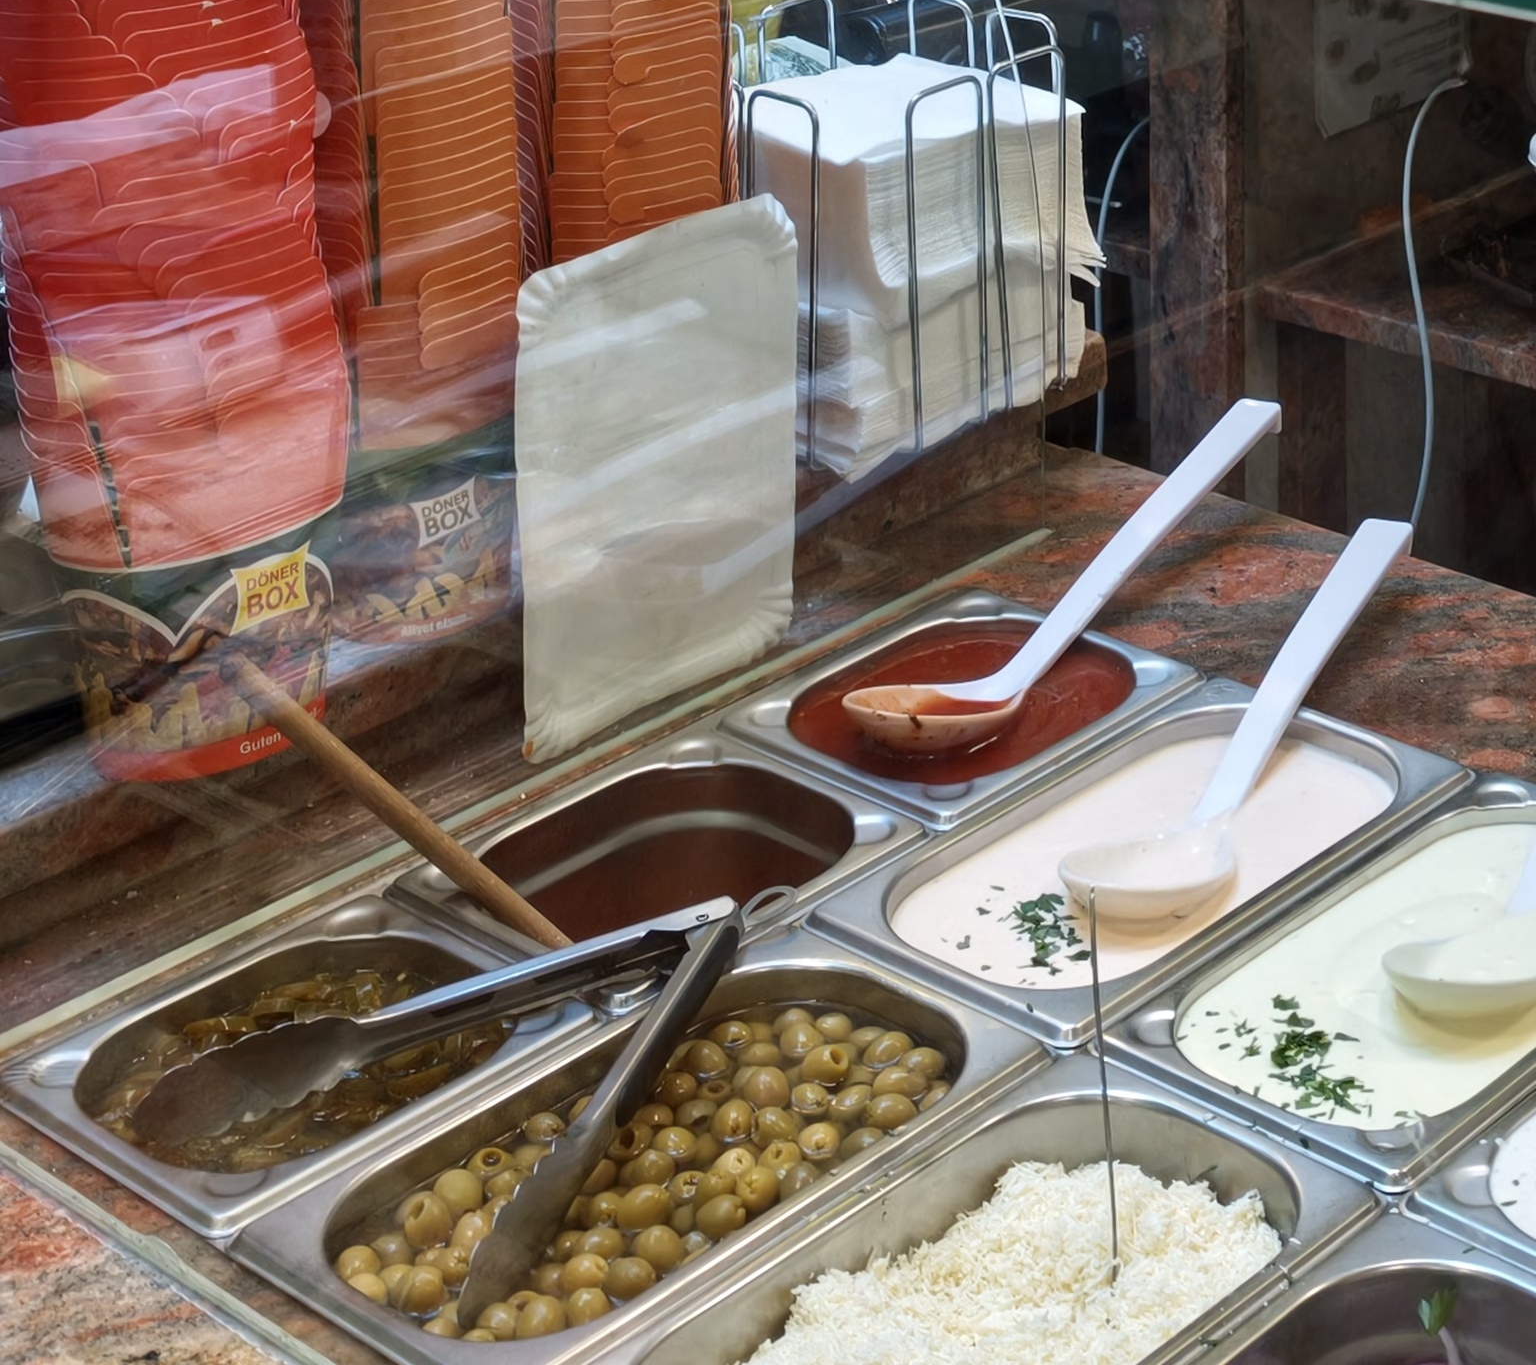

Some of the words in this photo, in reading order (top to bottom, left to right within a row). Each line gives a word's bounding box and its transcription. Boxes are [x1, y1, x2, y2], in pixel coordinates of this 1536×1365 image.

[421, 489, 470, 518] DÖNER
[423, 500, 474, 538] BOX
[246, 561, 300, 592] DÖNER
[246, 576, 300, 619] BOX
[240, 731, 281, 754] Guten
